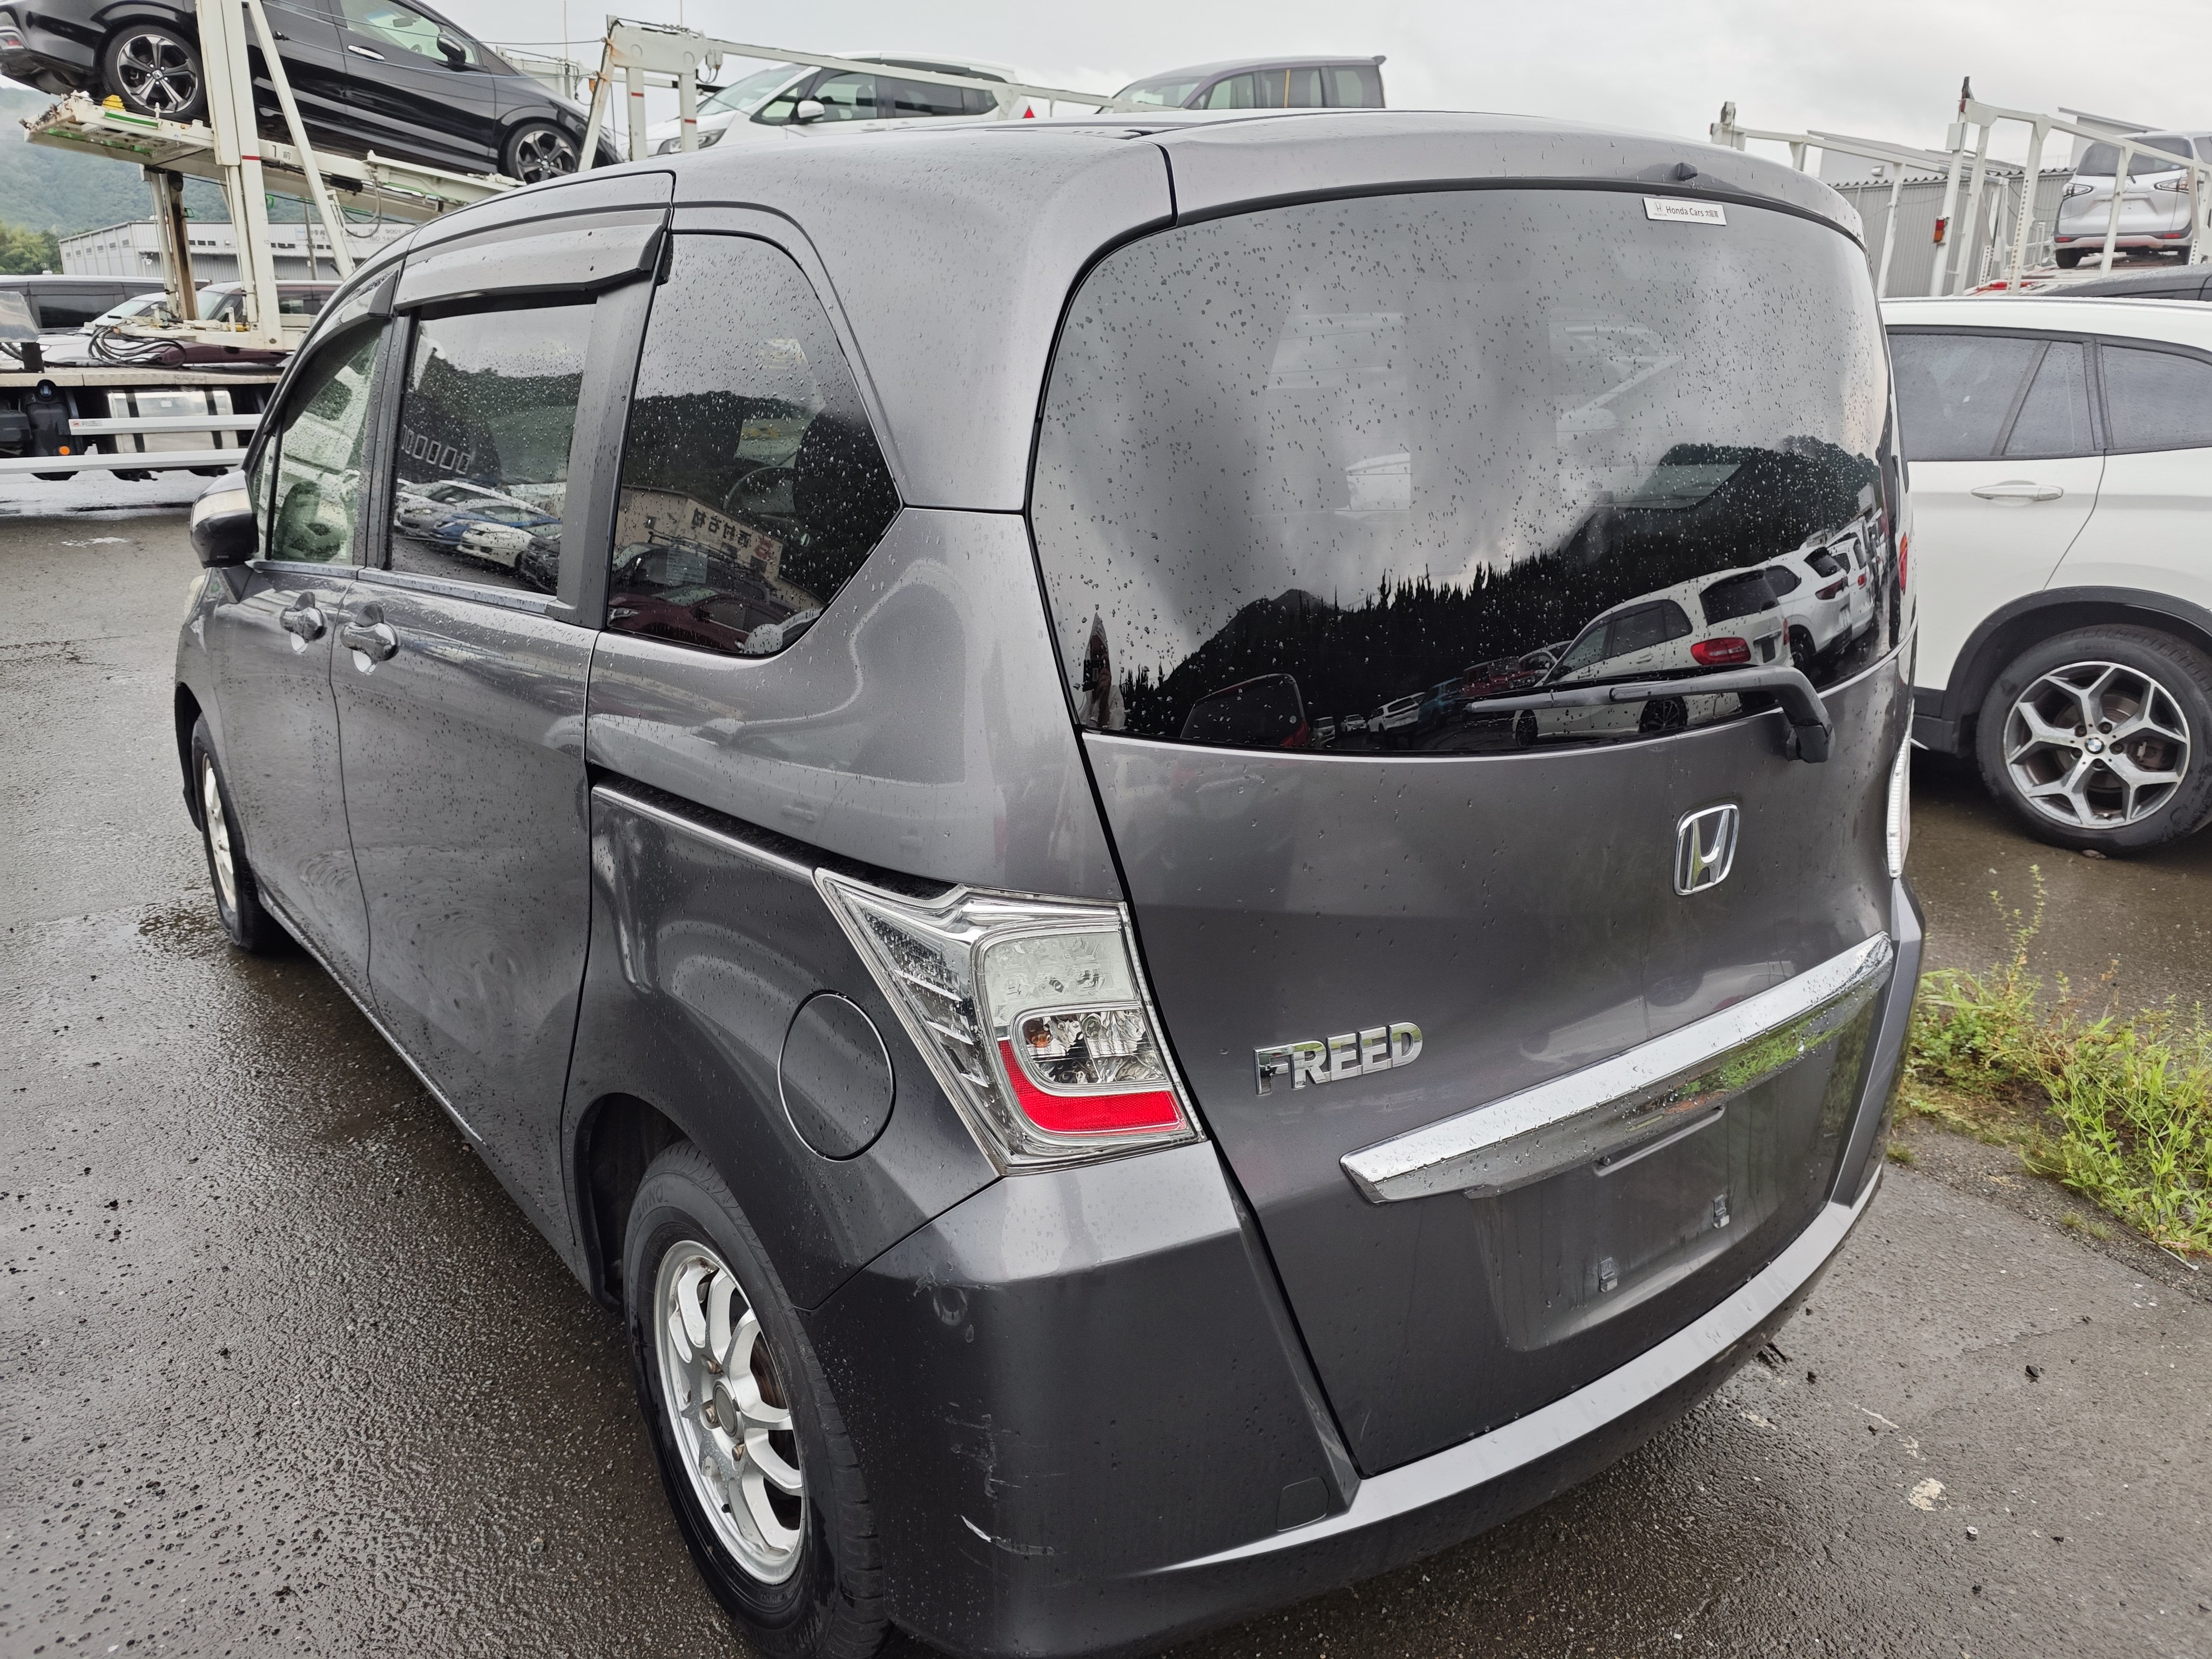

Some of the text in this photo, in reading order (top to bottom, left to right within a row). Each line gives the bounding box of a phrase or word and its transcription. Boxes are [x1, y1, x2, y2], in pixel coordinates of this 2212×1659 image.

[1665, 206, 1689, 215] Honda
[1689, 207, 1704, 217] Cars
[1253, 1021, 1424, 1096] FREED
